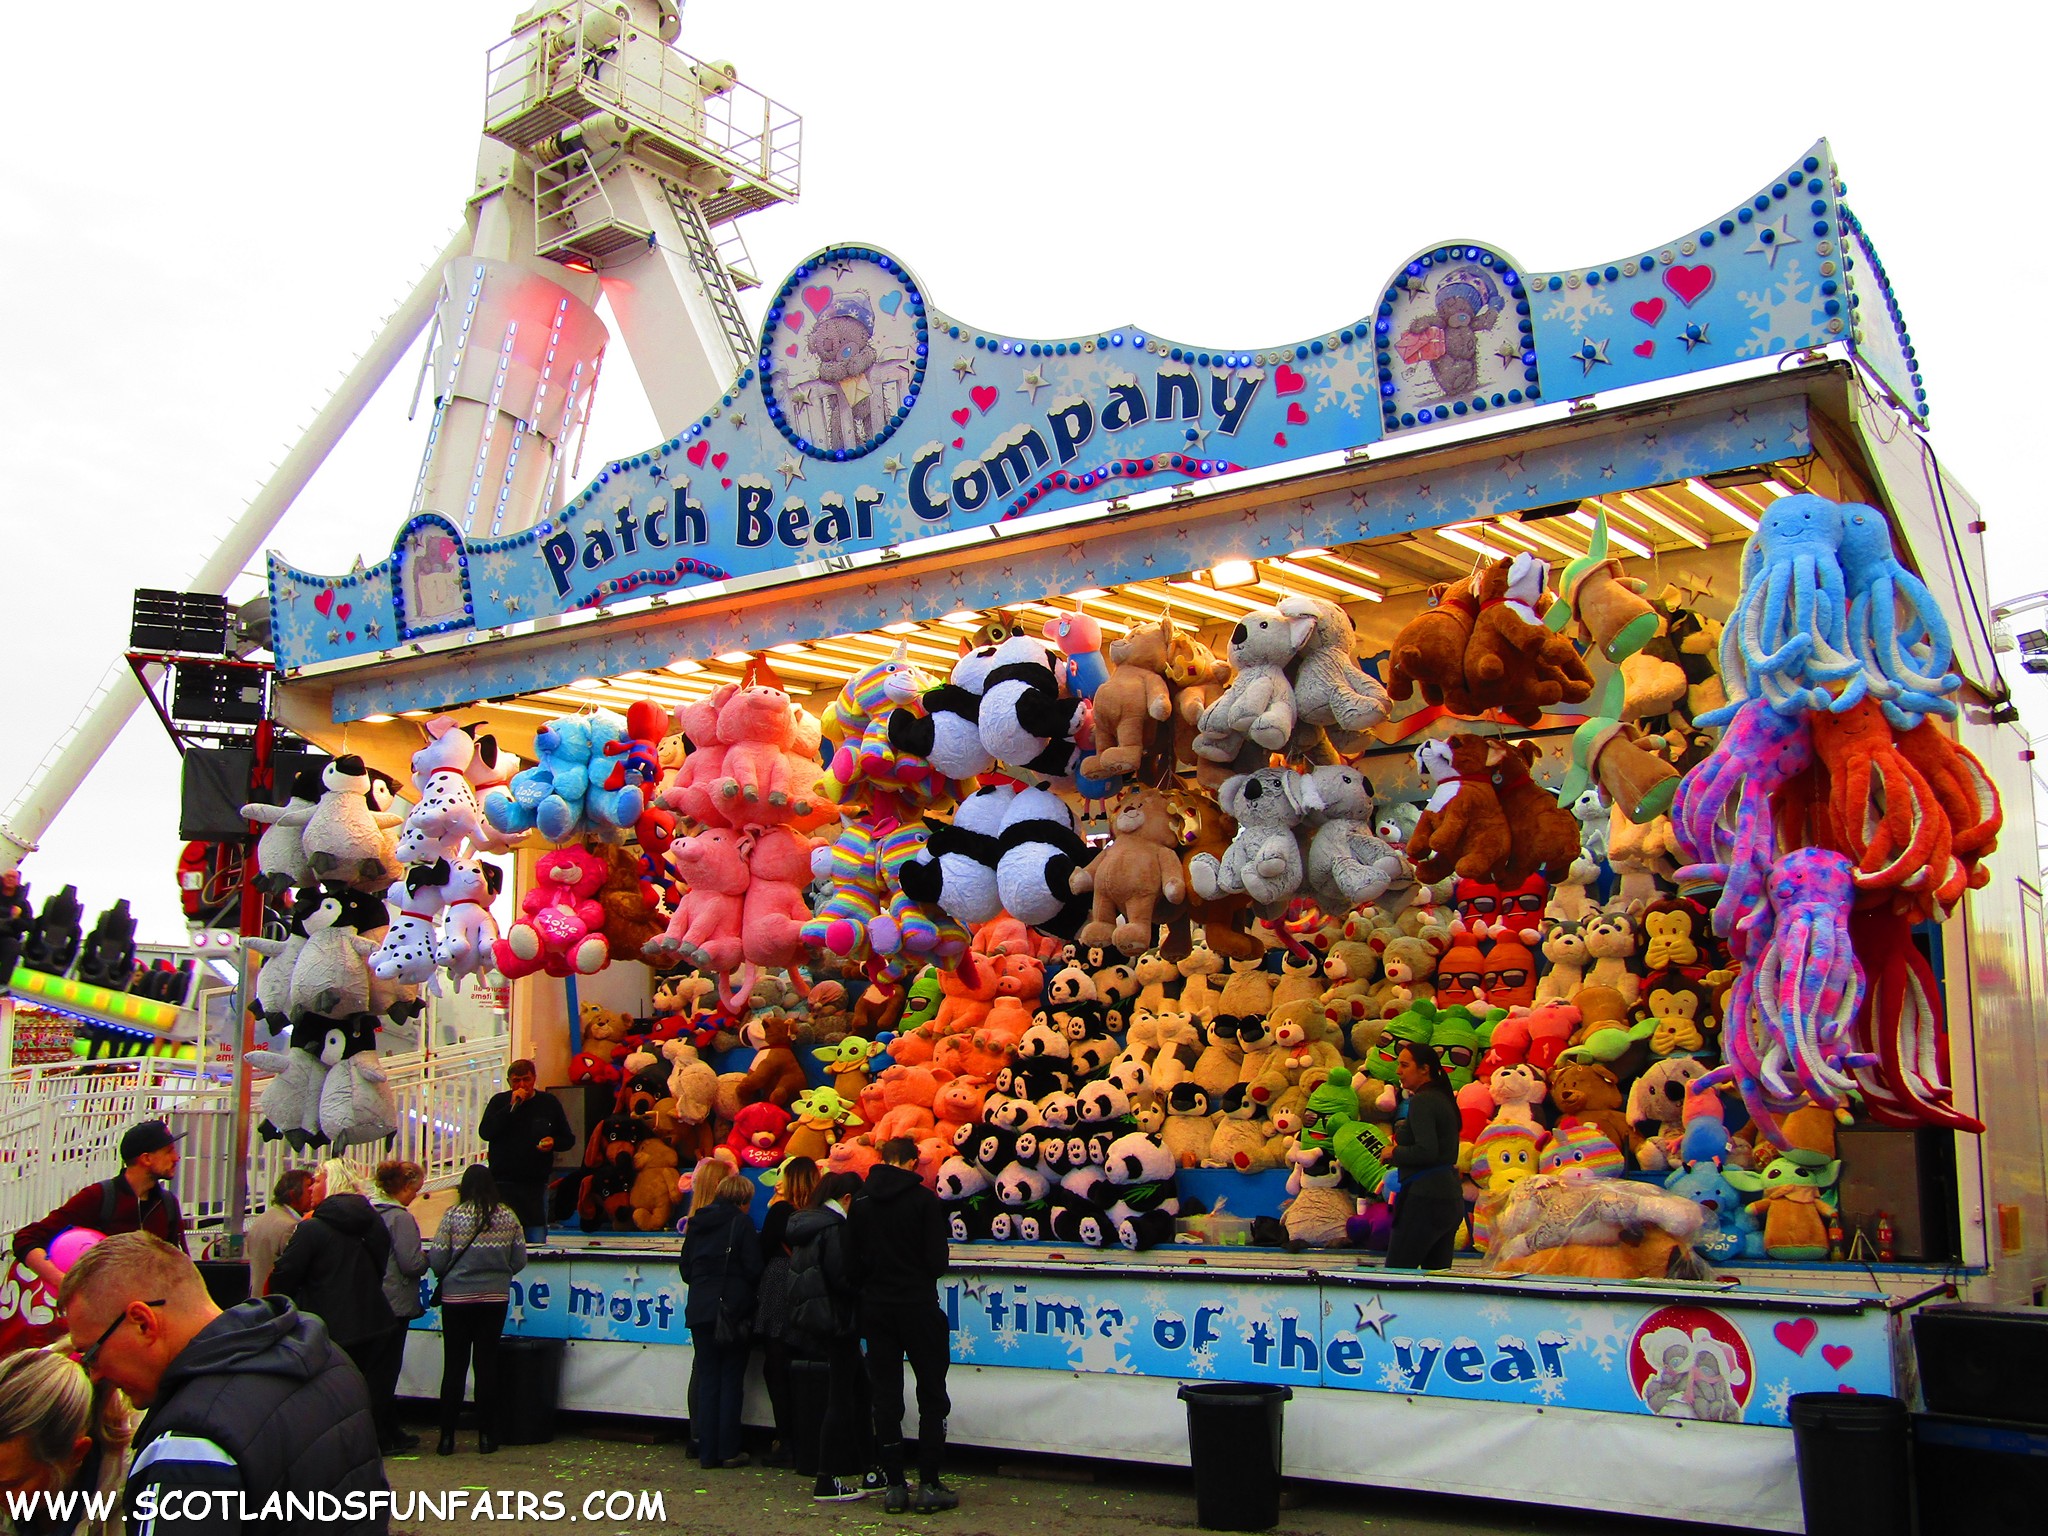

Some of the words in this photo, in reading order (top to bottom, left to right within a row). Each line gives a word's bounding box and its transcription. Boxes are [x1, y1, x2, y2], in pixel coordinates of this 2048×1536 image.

[540, 472, 708, 599] Patch
[735, 472, 885, 548] Bear
[908, 358, 1265, 521] Company
[1704, 1242, 1730, 1252] you
[568, 1279, 676, 1331] most
[984, 1280, 1125, 1338] time
[1152, 1299, 1226, 1354] of
[1246, 1306, 1366, 1376] the
[1391, 1329, 1572, 1392] year
